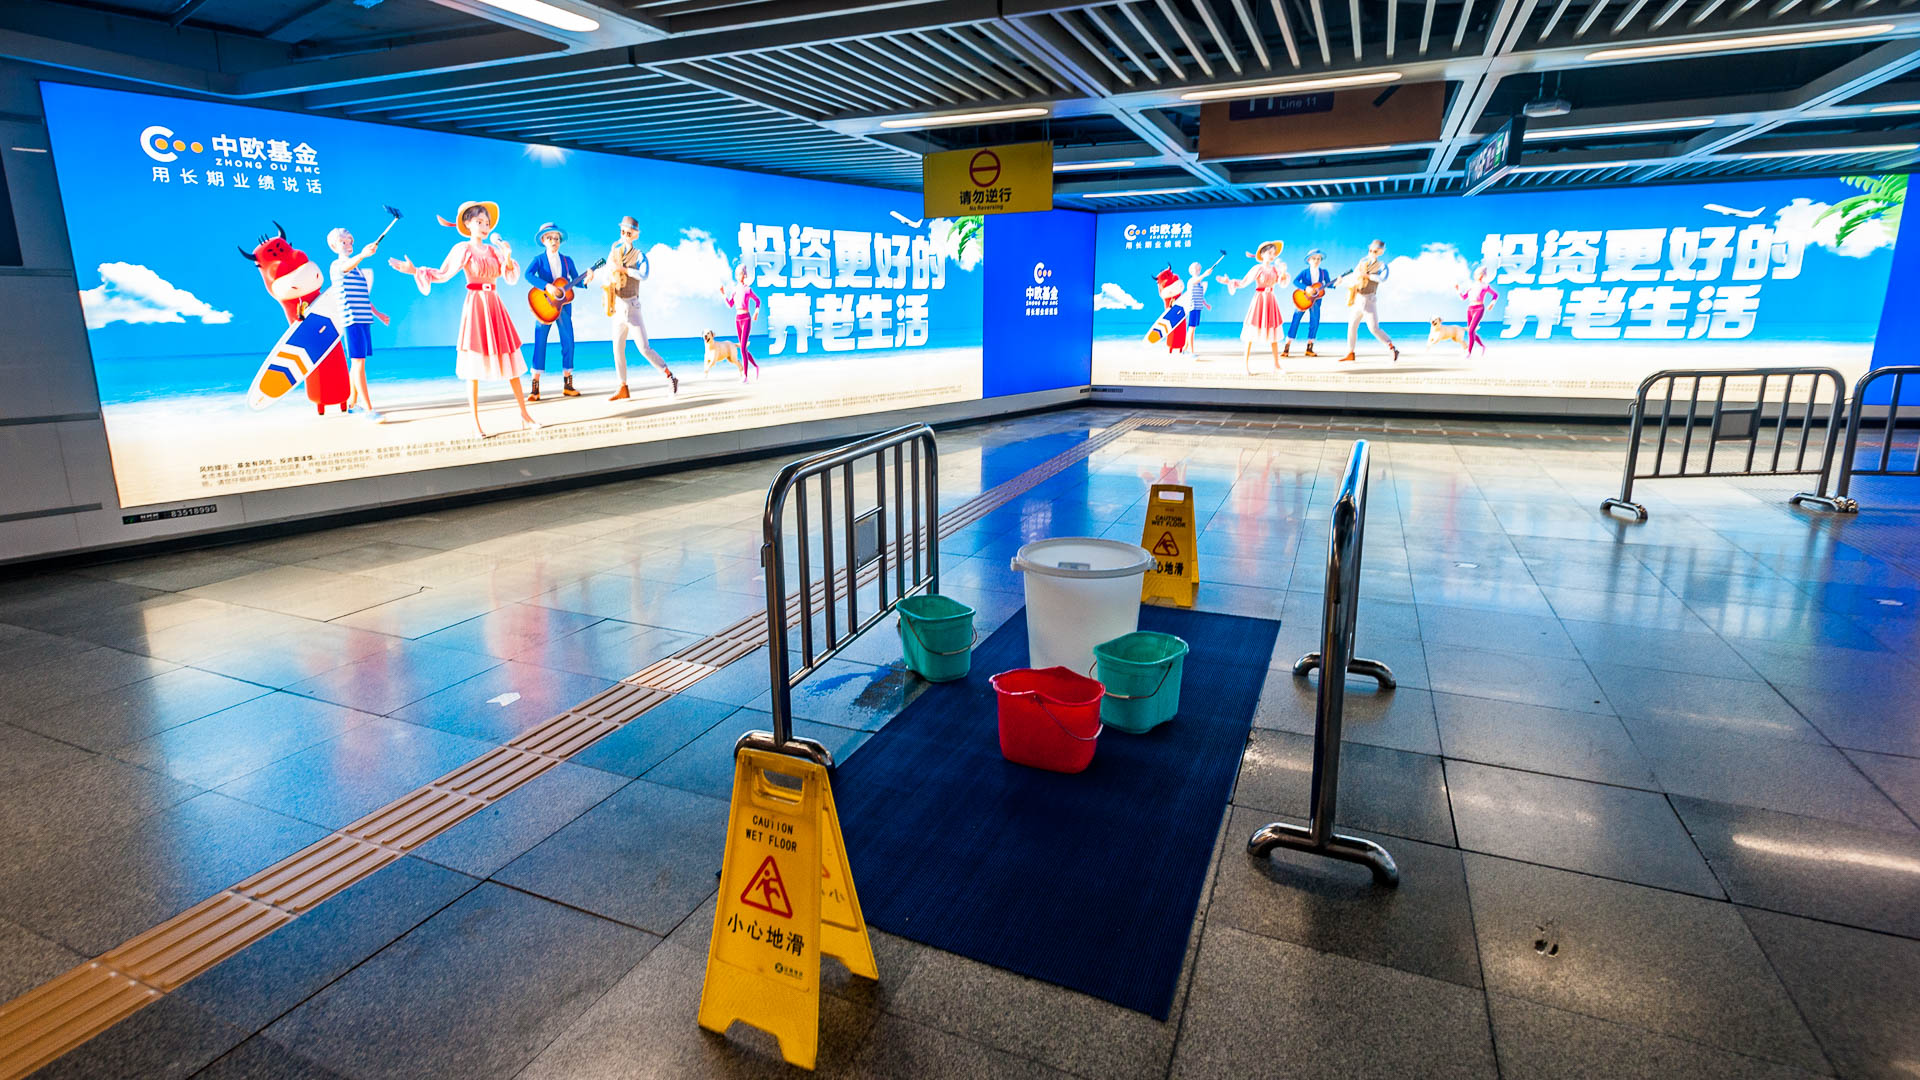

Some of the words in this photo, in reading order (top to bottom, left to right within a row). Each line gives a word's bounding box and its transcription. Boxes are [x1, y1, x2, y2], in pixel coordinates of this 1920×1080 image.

[1279, 99, 1302, 109] Line
[1306, 96, 1317, 107] 11
[211, 134, 319, 166] 中欧基金
[152, 166, 322, 194] 用长期业绩说话
[215, 158, 263, 170] ZHONG
[270, 162, 288, 172] OU
[295, 165, 321, 175] AMC
[959, 187, 1012, 205] 请勿逆行
[737, 222, 946, 290] 投资更好的
[1480, 223, 1805, 285] 投资更好的
[767, 292, 929, 355] 养老生活
[1499, 284, 1762, 339] 养老生活
[1147, 561, 1184, 577] 心地滑
[746, 827, 763, 843] WET
[768, 834, 797, 853] FLOOR
[727, 912, 805, 957] 小心地滑
